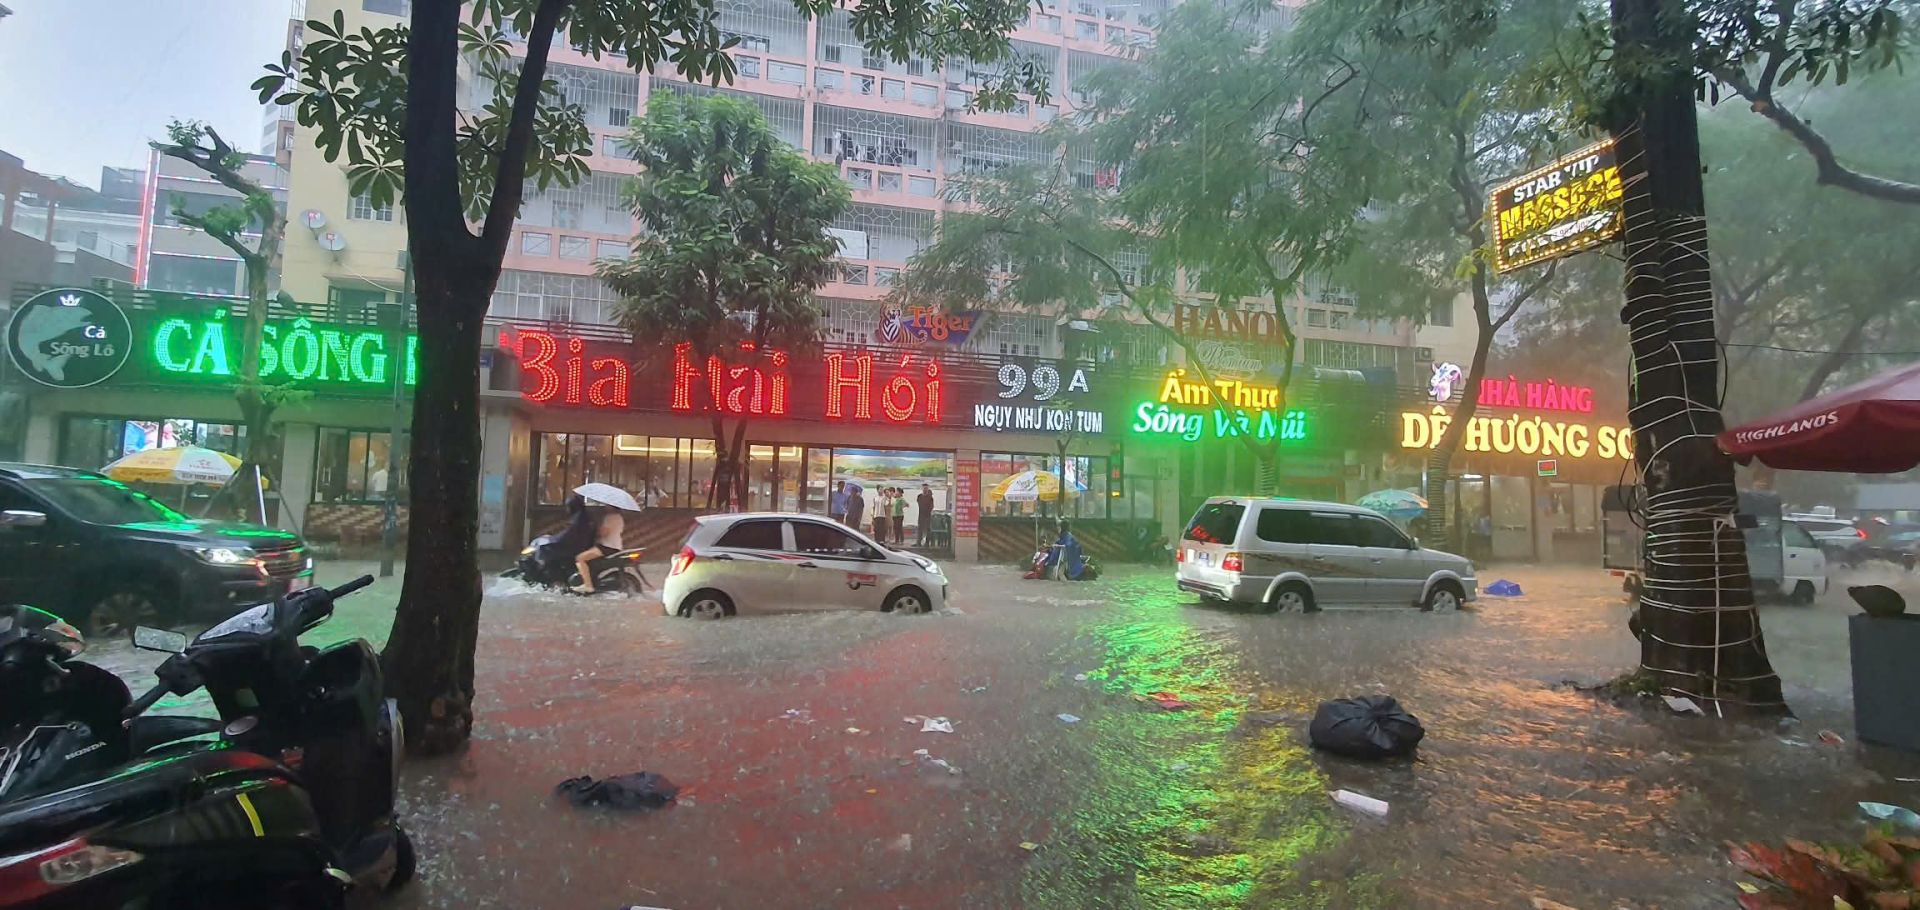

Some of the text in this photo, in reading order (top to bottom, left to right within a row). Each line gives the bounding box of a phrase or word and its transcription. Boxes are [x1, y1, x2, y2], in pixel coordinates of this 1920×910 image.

[1500, 166, 1624, 241] MASSAGE
[1514, 171, 1561, 203] STAR
[84, 325, 106, 339] Cá
[909, 305, 972, 341] Tiger
[49, 342, 91, 358] Sông
[155, 309, 231, 375] CÁ
[258, 317, 388, 383] SÔNG
[516, 331, 628, 407] Bia
[998, 364, 1089, 401] 99 A
[1526, 379, 1592, 413] HÀNG
[975, 404, 1102, 433] NGỤY NHƯ KON TUM
[1133, 402, 1204, 442] Sông
[1464, 413, 1590, 458] HƯƠNG
[1735, 410, 1839, 444] HIGHLANDS
[65, 741, 107, 760] HONDA
